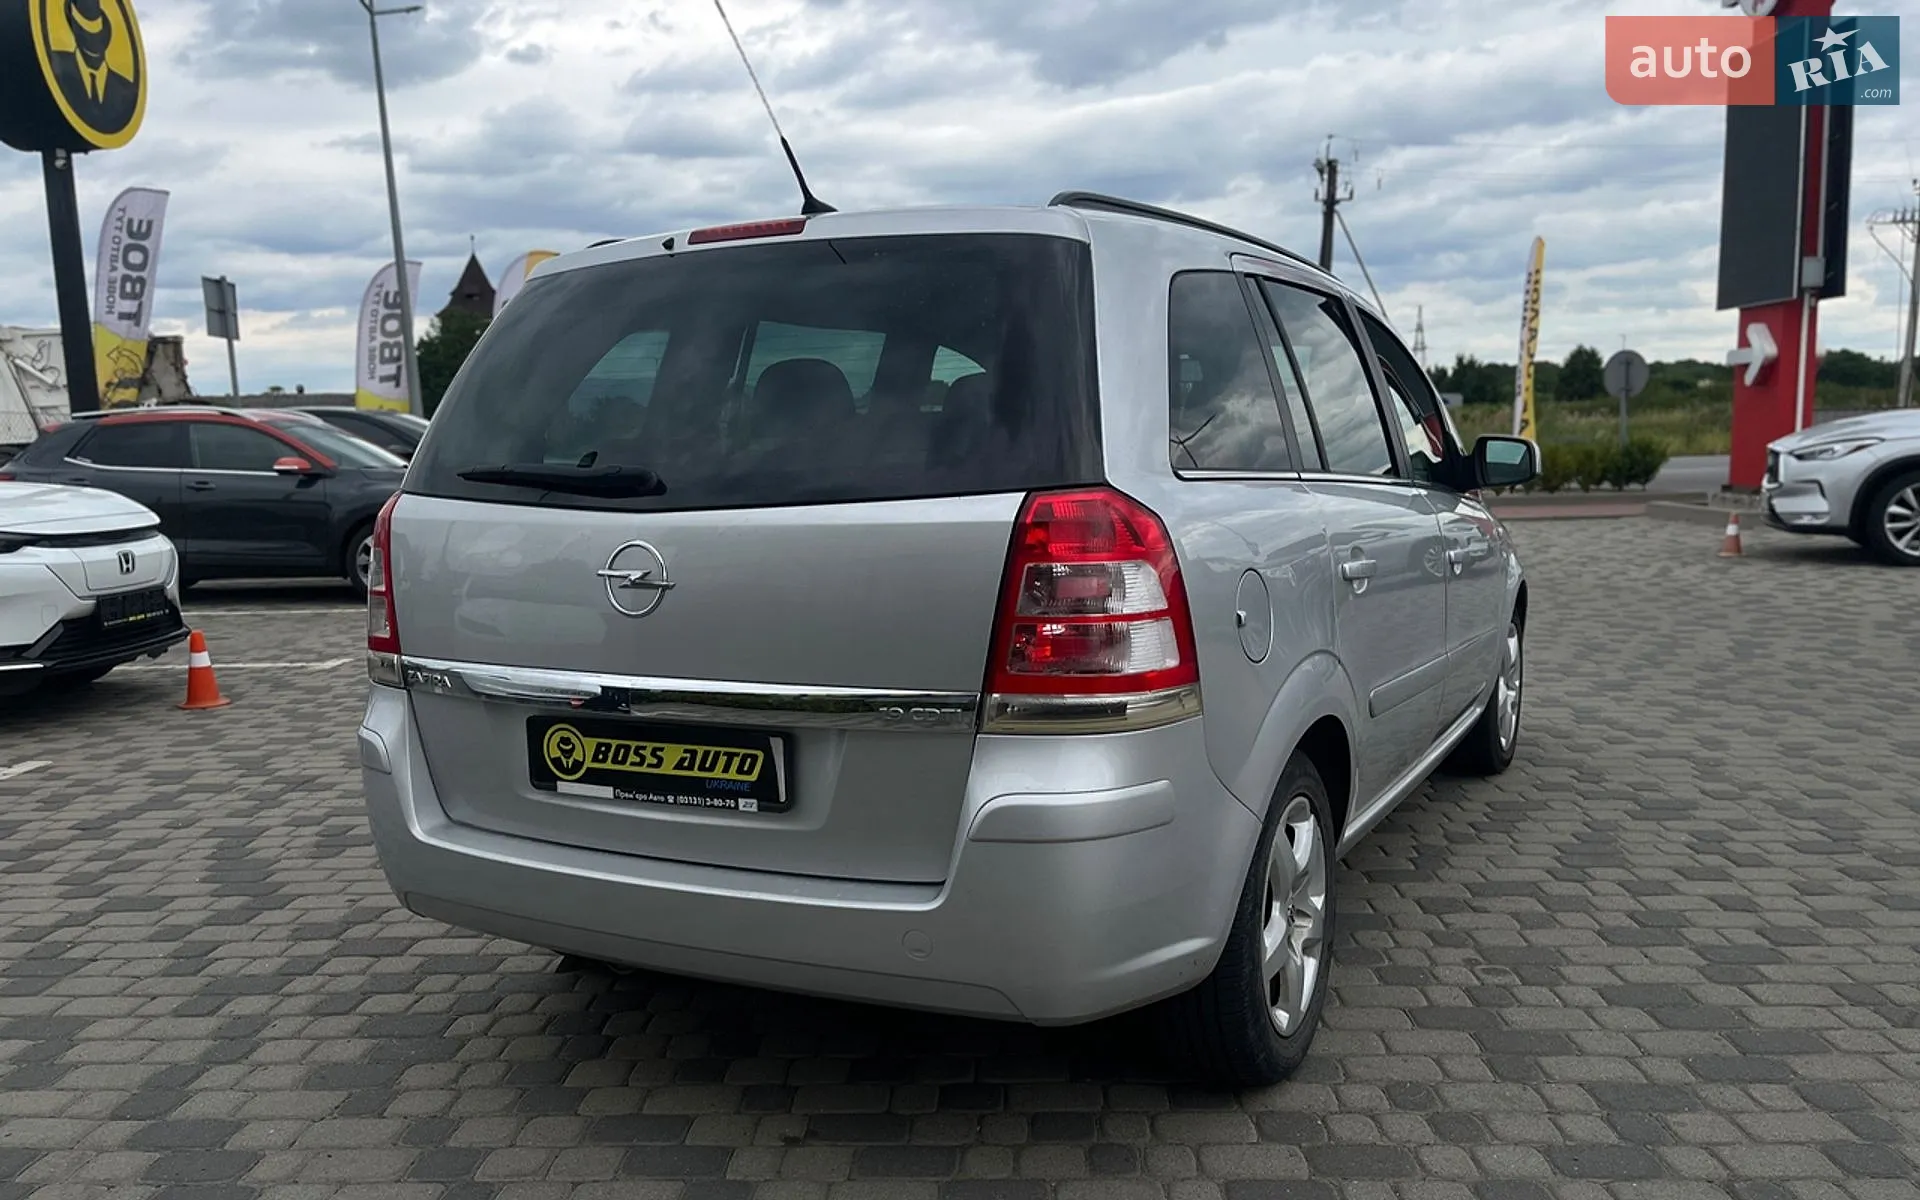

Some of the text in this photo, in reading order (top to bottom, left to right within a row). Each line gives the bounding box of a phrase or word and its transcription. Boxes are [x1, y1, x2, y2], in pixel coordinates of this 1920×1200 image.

[591, 742, 760, 776] BOSS AUTO
[705, 779, 752, 792] UKRAINE
